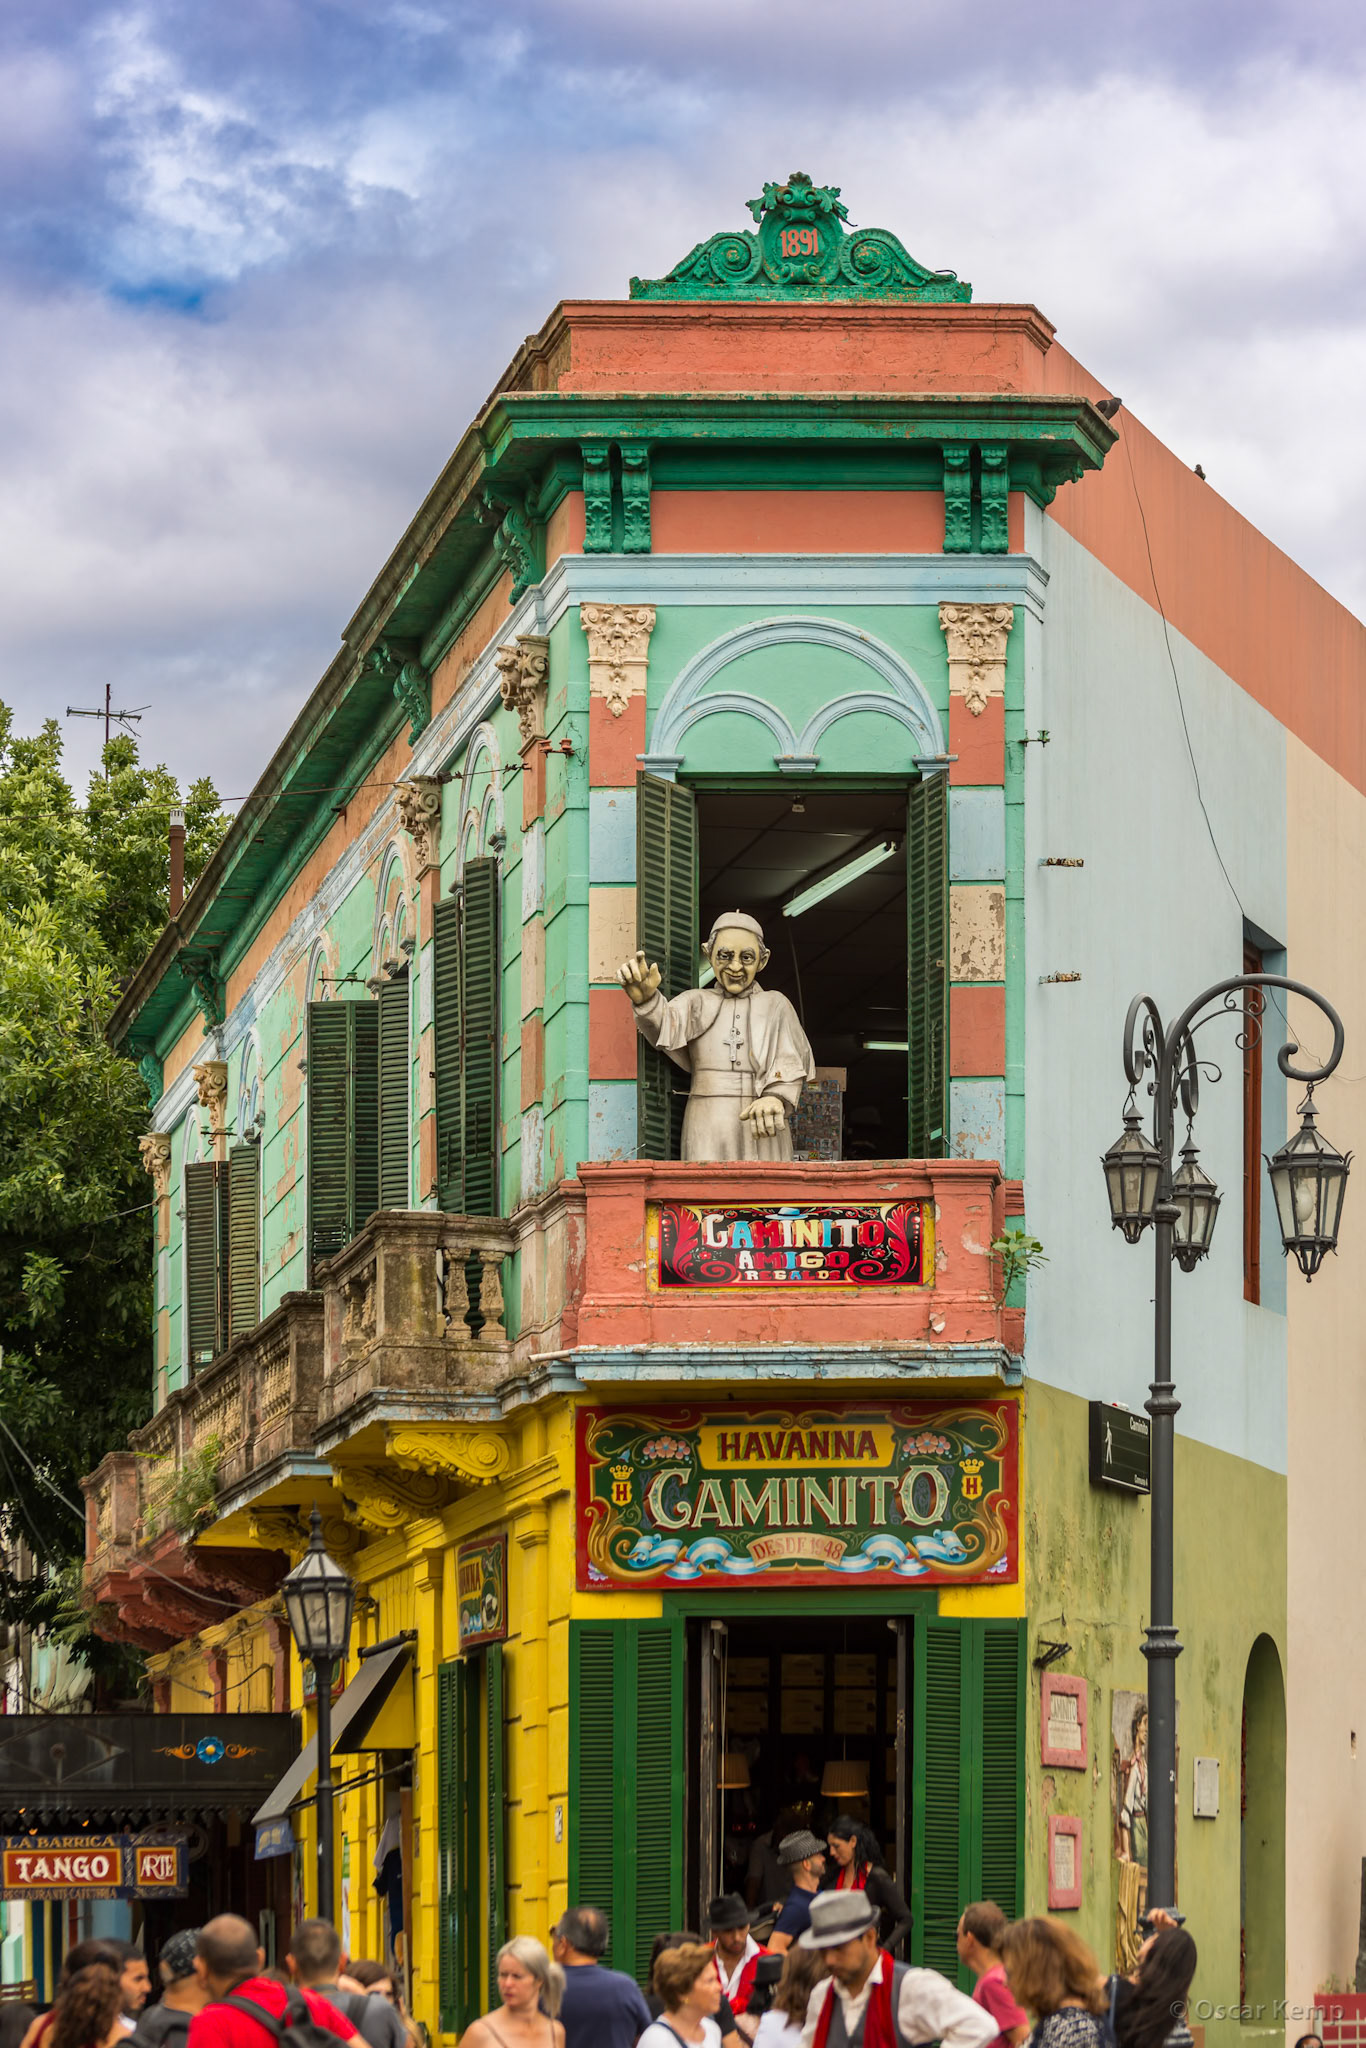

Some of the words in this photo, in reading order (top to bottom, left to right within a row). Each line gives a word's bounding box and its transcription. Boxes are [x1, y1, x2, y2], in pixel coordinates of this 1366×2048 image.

[780, 228, 818, 258] 1891
[700, 1213, 886, 1248] CAMINITO
[737, 1250, 850, 1270] AMIGO
[743, 1270, 841, 1281] REGALOS
[717, 1430, 880, 1462] HAVANNA
[615, 1483, 629, 1502] H
[646, 1464, 951, 1530] CAMINITO
[966, 1477, 978, 1496] H
[752, 1537, 807, 1560] DESDE
[810, 1536, 843, 1561] 1948
[5, 1836, 32, 1849] LA
[36, 1834, 116, 1848] BARRICA
[15, 1855, 110, 1883] TANGO
[140, 1854, 174, 1880] ARTE
